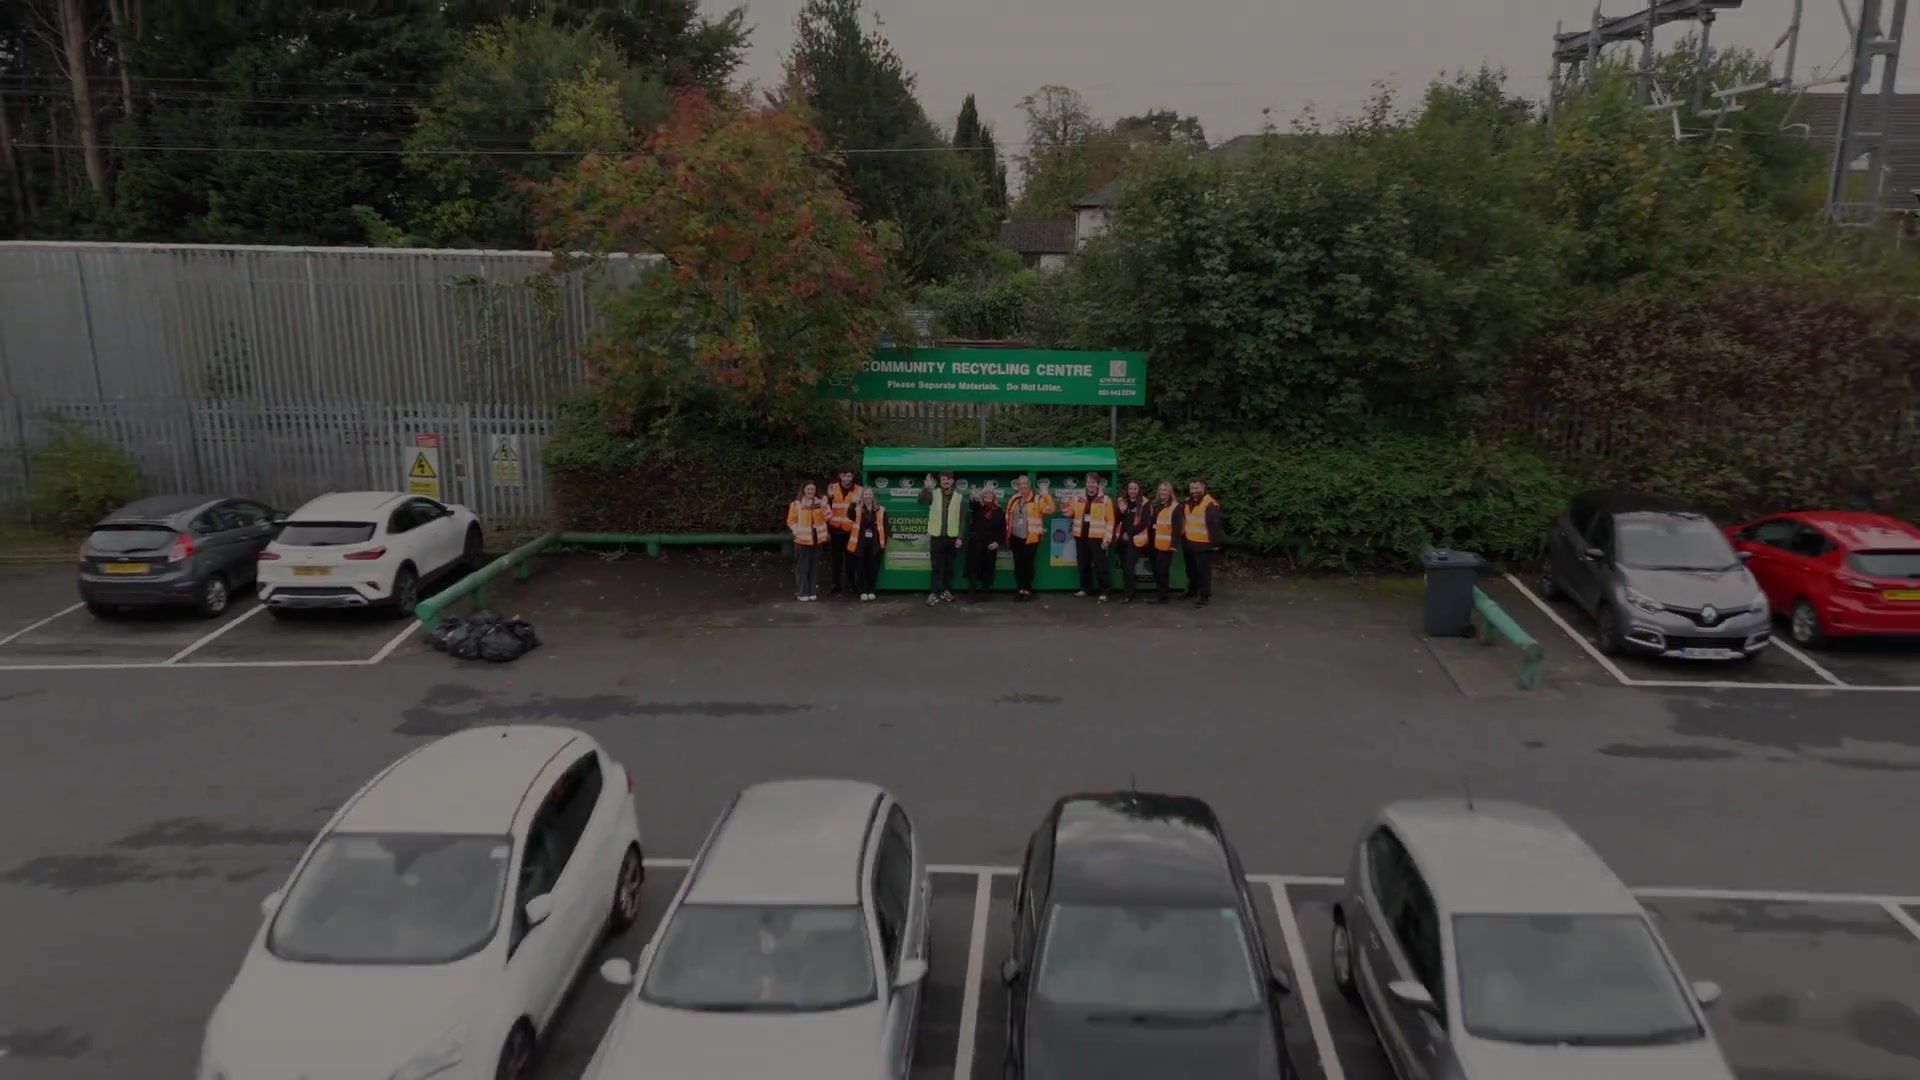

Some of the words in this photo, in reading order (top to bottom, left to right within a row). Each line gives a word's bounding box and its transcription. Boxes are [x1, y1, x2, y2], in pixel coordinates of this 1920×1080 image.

[862, 361, 946, 374] COMMUNITY
[952, 362, 1030, 376] RECYCLING
[1036, 363, 1093, 377] CENTRE
[887, 380, 915, 389] Please
[918, 381, 956, 391] Separate
[958, 381, 1000, 391] Materials.
[1006, 382, 1019, 392] Do
[1021, 383, 1036, 392] Not
[1037, 383, 1063, 393] Litter.
[888, 517, 929, 525] CLOTHING
